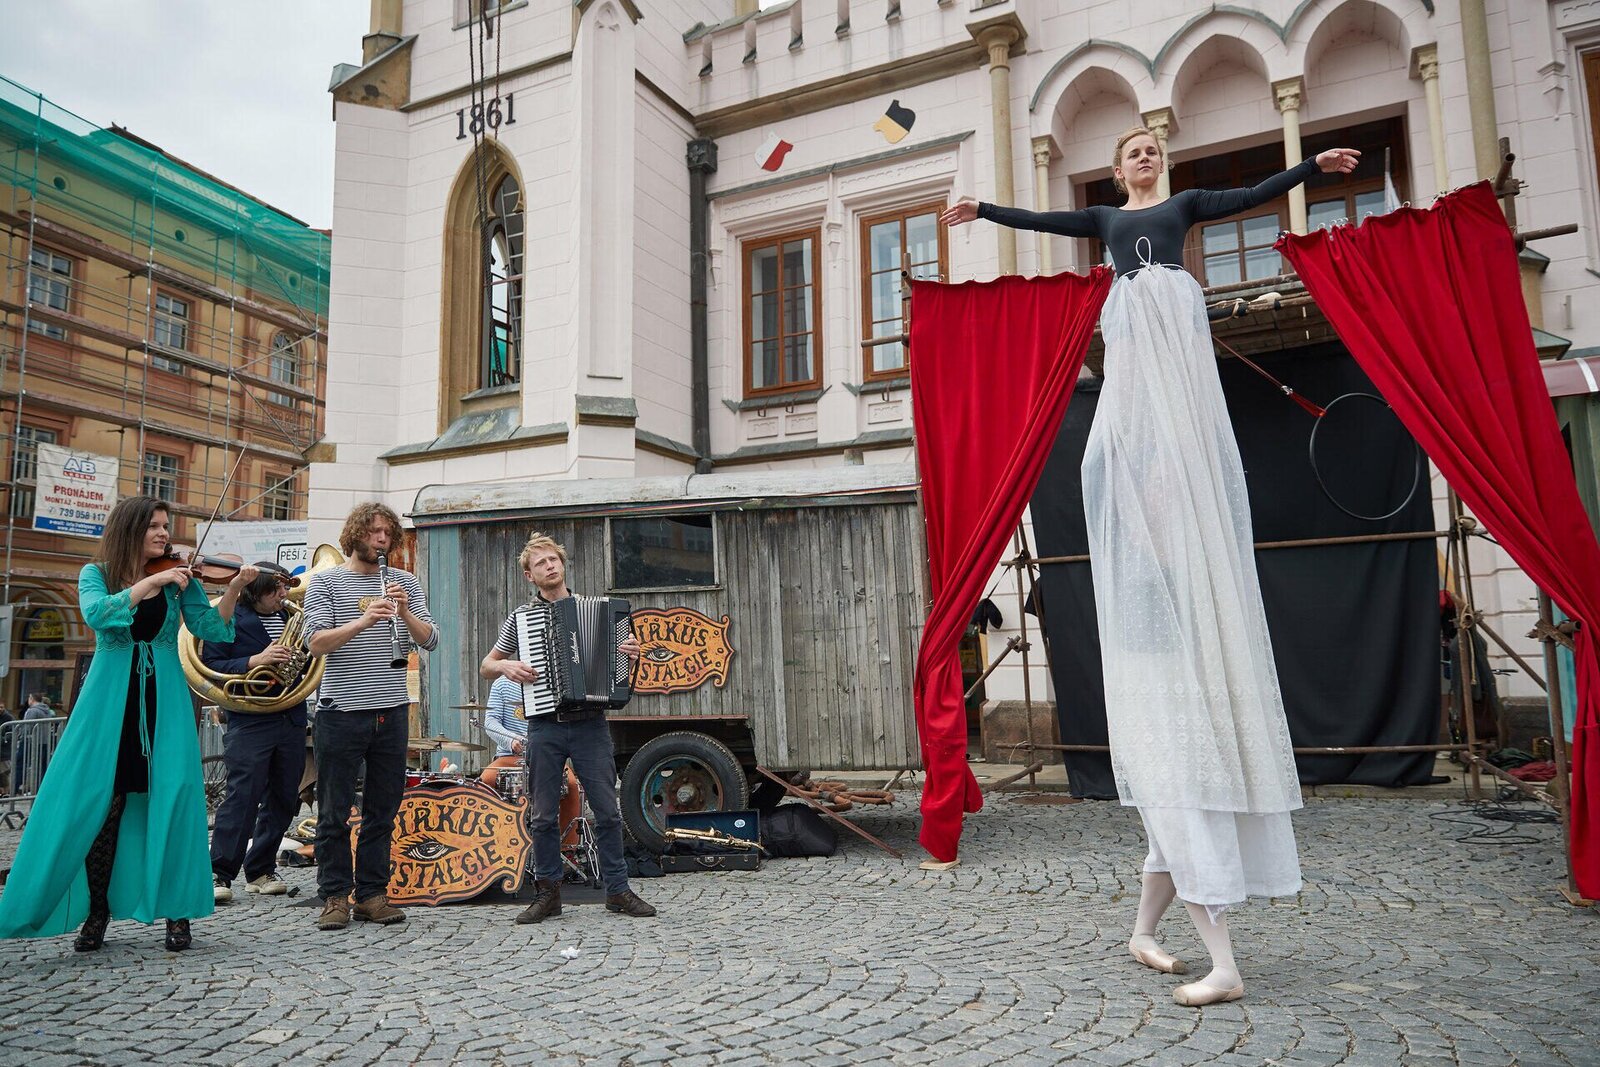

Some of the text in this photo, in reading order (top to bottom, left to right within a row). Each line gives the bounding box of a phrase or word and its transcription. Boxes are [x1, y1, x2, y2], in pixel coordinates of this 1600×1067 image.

[456, 93, 516, 140] 1861
[64, 458, 96, 474] AB
[54, 485, 104, 501] PRONÁJEM
[59, 507, 106, 521] 739 058 117
[280, 548, 300, 560] PĚŠÍ
[636, 620, 709, 647] IRKUS
[397, 804, 499, 838] IRKUS
